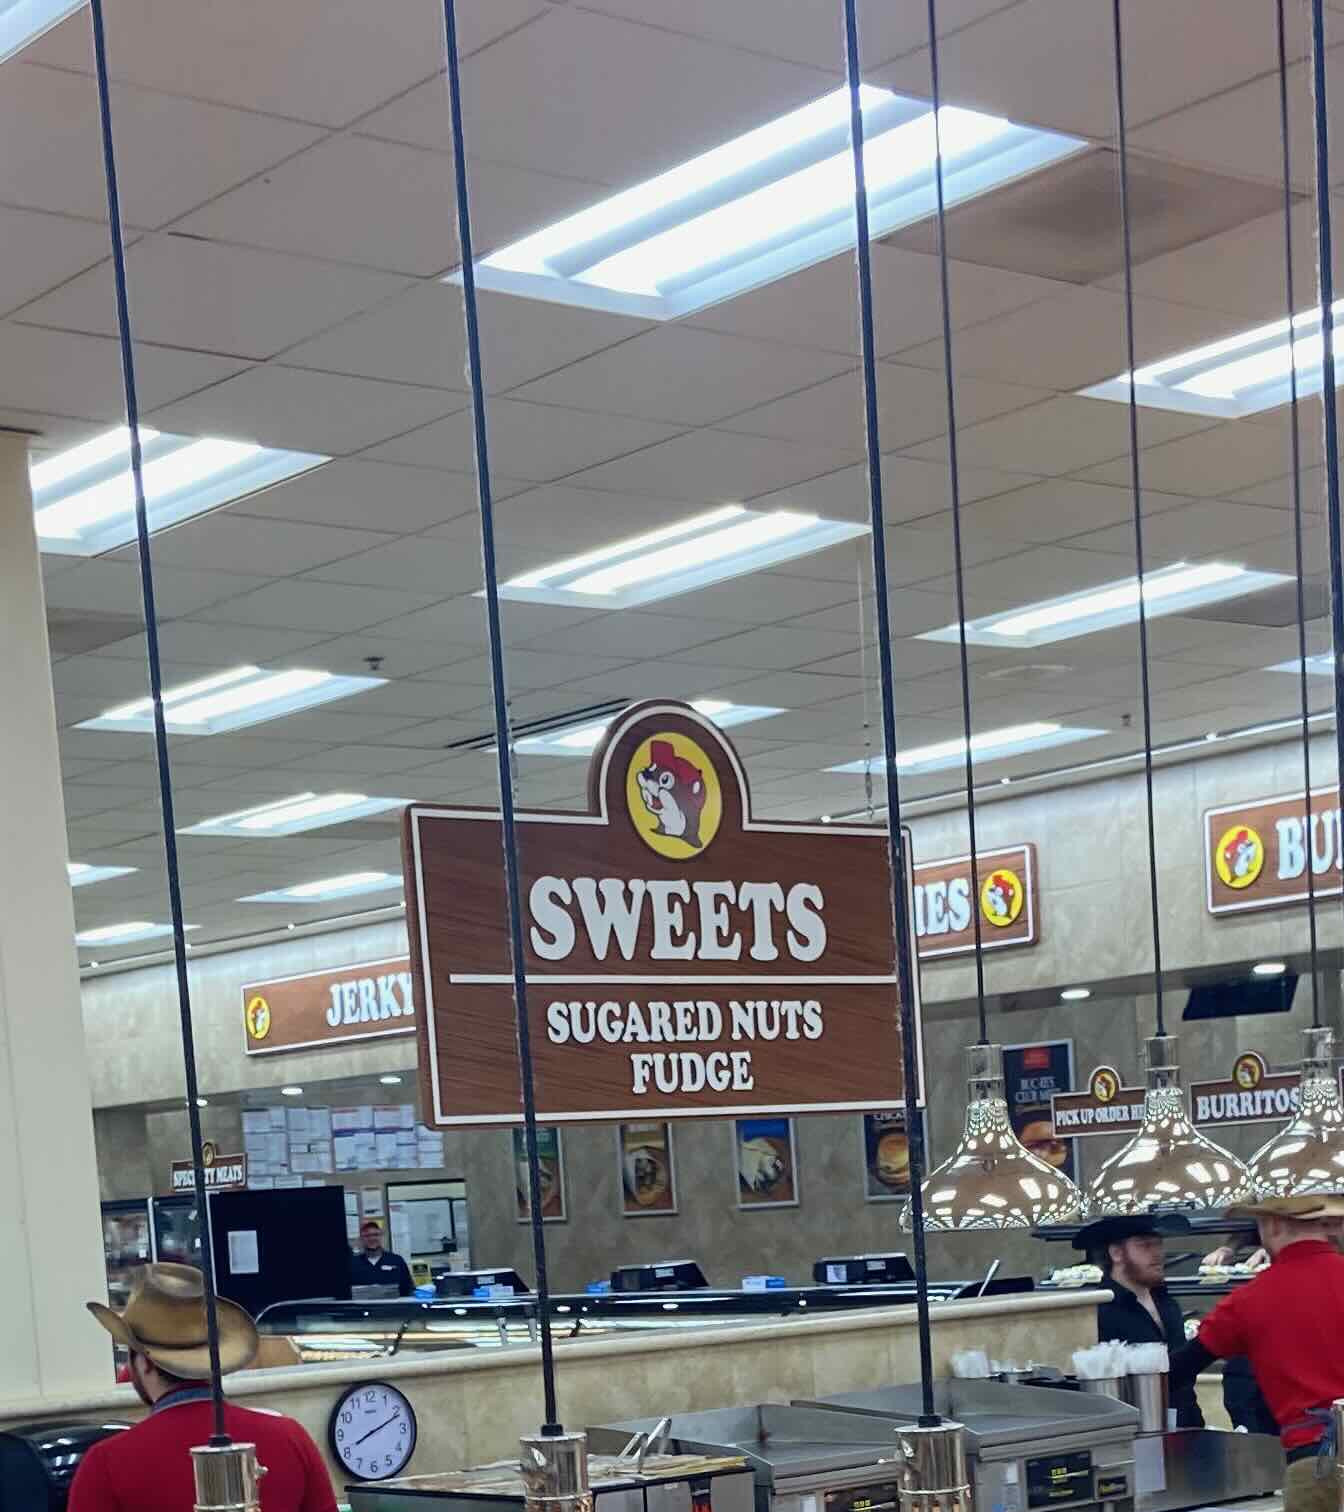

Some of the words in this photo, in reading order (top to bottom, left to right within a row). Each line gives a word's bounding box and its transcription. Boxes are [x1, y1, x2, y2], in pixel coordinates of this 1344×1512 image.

[529, 875, 826, 962] SWEETS
[326, 972, 415, 1026] JERKY
[546, 1001, 722, 1044] SUGARED
[731, 1000, 824, 1042] NUTS
[631, 1050, 754, 1095] FUDGE
[1197, 1087, 1301, 1120] BURRITOS
[1056, 1109, 1081, 1126] PICK
[1080, 1107, 1094, 1124] UP
[1095, 1105, 1130, 1123] ORDER
[350, 1397, 360, 1409] 11
[362, 1390, 376, 1403] 12
[340, 1411, 352, 1424] 10
[337, 1428, 344, 1441] 9
[399, 1422, 407, 1434] 3
[343, 1446, 352, 1459] 8
[355, 1457, 363, 1470] 7
[370, 1460, 378, 1473] 6
[385, 1454, 393, 1466] 5
